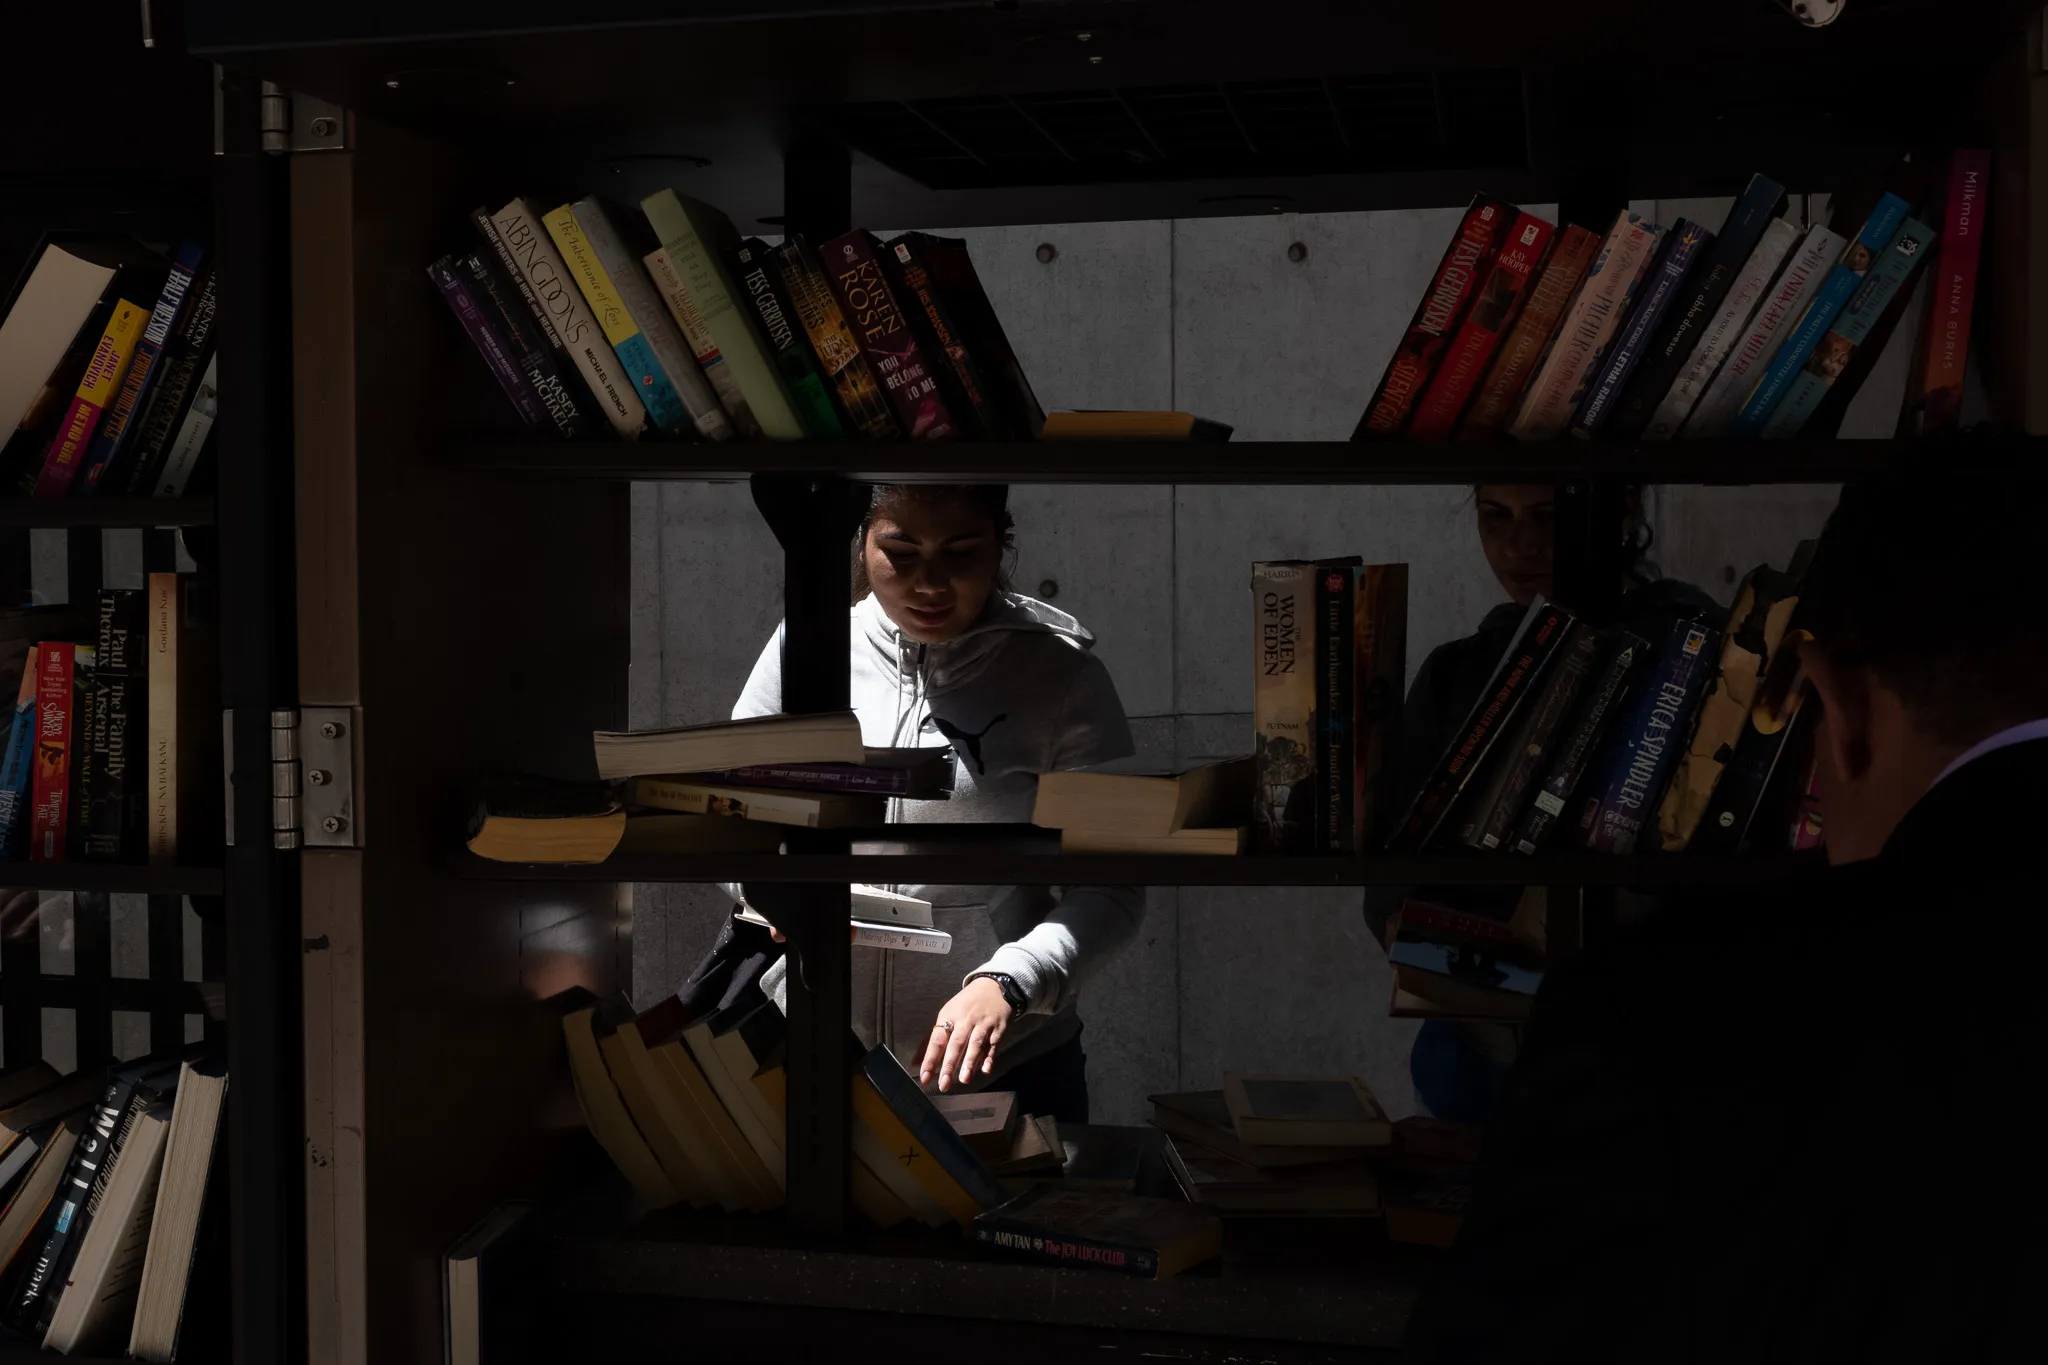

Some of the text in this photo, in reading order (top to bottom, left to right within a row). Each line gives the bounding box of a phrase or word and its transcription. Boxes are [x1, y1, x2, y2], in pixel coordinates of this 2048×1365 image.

[555, 209, 578, 237] The
[1957, 171, 1978, 234] Milkman
[568, 237, 601, 290] Inheritance
[1499, 252, 1532, 275] HOOPER
[1510, 249, 1528, 261] KAY
[159, 269, 191, 305] HALF
[476, 213, 563, 348] JEWISH PRAYERS of HOPE and HEALING
[501, 211, 592, 343] ABINGDON'S
[594, 290, 609, 304] of
[805, 270, 833, 308] JAMES
[856, 261, 900, 332] KAREN
[1418, 235, 1483, 336] TESS GERRITSEN
[1777, 264, 1810, 304] LINDA
[143, 300, 175, 344] NELSON
[598, 299, 625, 330] Loss
[743, 268, 795, 351] TESS GERRITSEN
[837, 269, 886, 341] ROSE
[1570, 294, 1613, 352] PILCHER
[1686, 293, 1708, 319] abha
[1941, 275, 1963, 369] ANNA BURNS
[819, 336, 850, 358] JUDAS
[823, 335, 838, 345] THE
[1502, 335, 1532, 379] DEADLY
[1663, 318, 1693, 358] dawesar
[1730, 330, 1767, 376] MILLER
[1777, 338, 1807, 377] COMMITTEE
[83, 334, 114, 388] EVANOVICH
[100, 350, 120, 381] JANET
[124, 347, 154, 388] JEROME
[166, 351, 197, 407] MURDER
[877, 357, 900, 374] YOU
[886, 363, 925, 390] BELONG
[1446, 330, 1486, 389] TOUCHING
[545, 374, 579, 419] KASEY
[583, 348, 628, 416] MICHAEL FRENCH
[907, 377, 937, 400] TO ME
[1382, 360, 1417, 404] SILENT
[1582, 350, 1629, 426] LETHAL RANSOM
[159, 408, 174, 426] AT
[527, 369, 576, 438] MICHAELS
[1366, 400, 1397, 435] GIRL
[55, 403, 92, 466] METRO GIRL
[98, 597, 115, 665] Theroux
[111, 629, 128, 666] Paul
[157, 612, 167, 652] Gordana
[1263, 592, 1279, 677] OF EDEN
[1279, 595, 1295, 676] WOMEN
[1328, 599, 1342, 711] Little Earthquakes
[1518, 653, 1533, 669] THE
[1496, 685, 1512, 702] AND
[1647, 681, 1685, 732] ERICA
[40, 702, 55, 736] SAWYER
[53, 711, 64, 735] MERYL
[82, 693, 93, 739] BEYOND
[93, 682, 110, 751] Arsenal
[104, 683, 126, 778] The Family
[1266, 722, 1300, 730] PUTNAM
[81, 755, 90, 782] WALL
[1327, 742, 1342, 832] Jennifer Weiner
[1617, 731, 1665, 809] SPINDLER
[38, 804, 49, 819] FATE
[49, 790, 62, 825] TEMPTING
[882, 933, 898, 945] Dogs
[925, 940, 937, 948] KATZ
[993, 1230, 1031, 1250] AMY TAN
[1043, 1239, 1062, 1255] The
[1061, 1242, 1077, 1258] JOY
[1076, 1245, 1101, 1262] LUCK
[19, 1256, 53, 1308] marks
